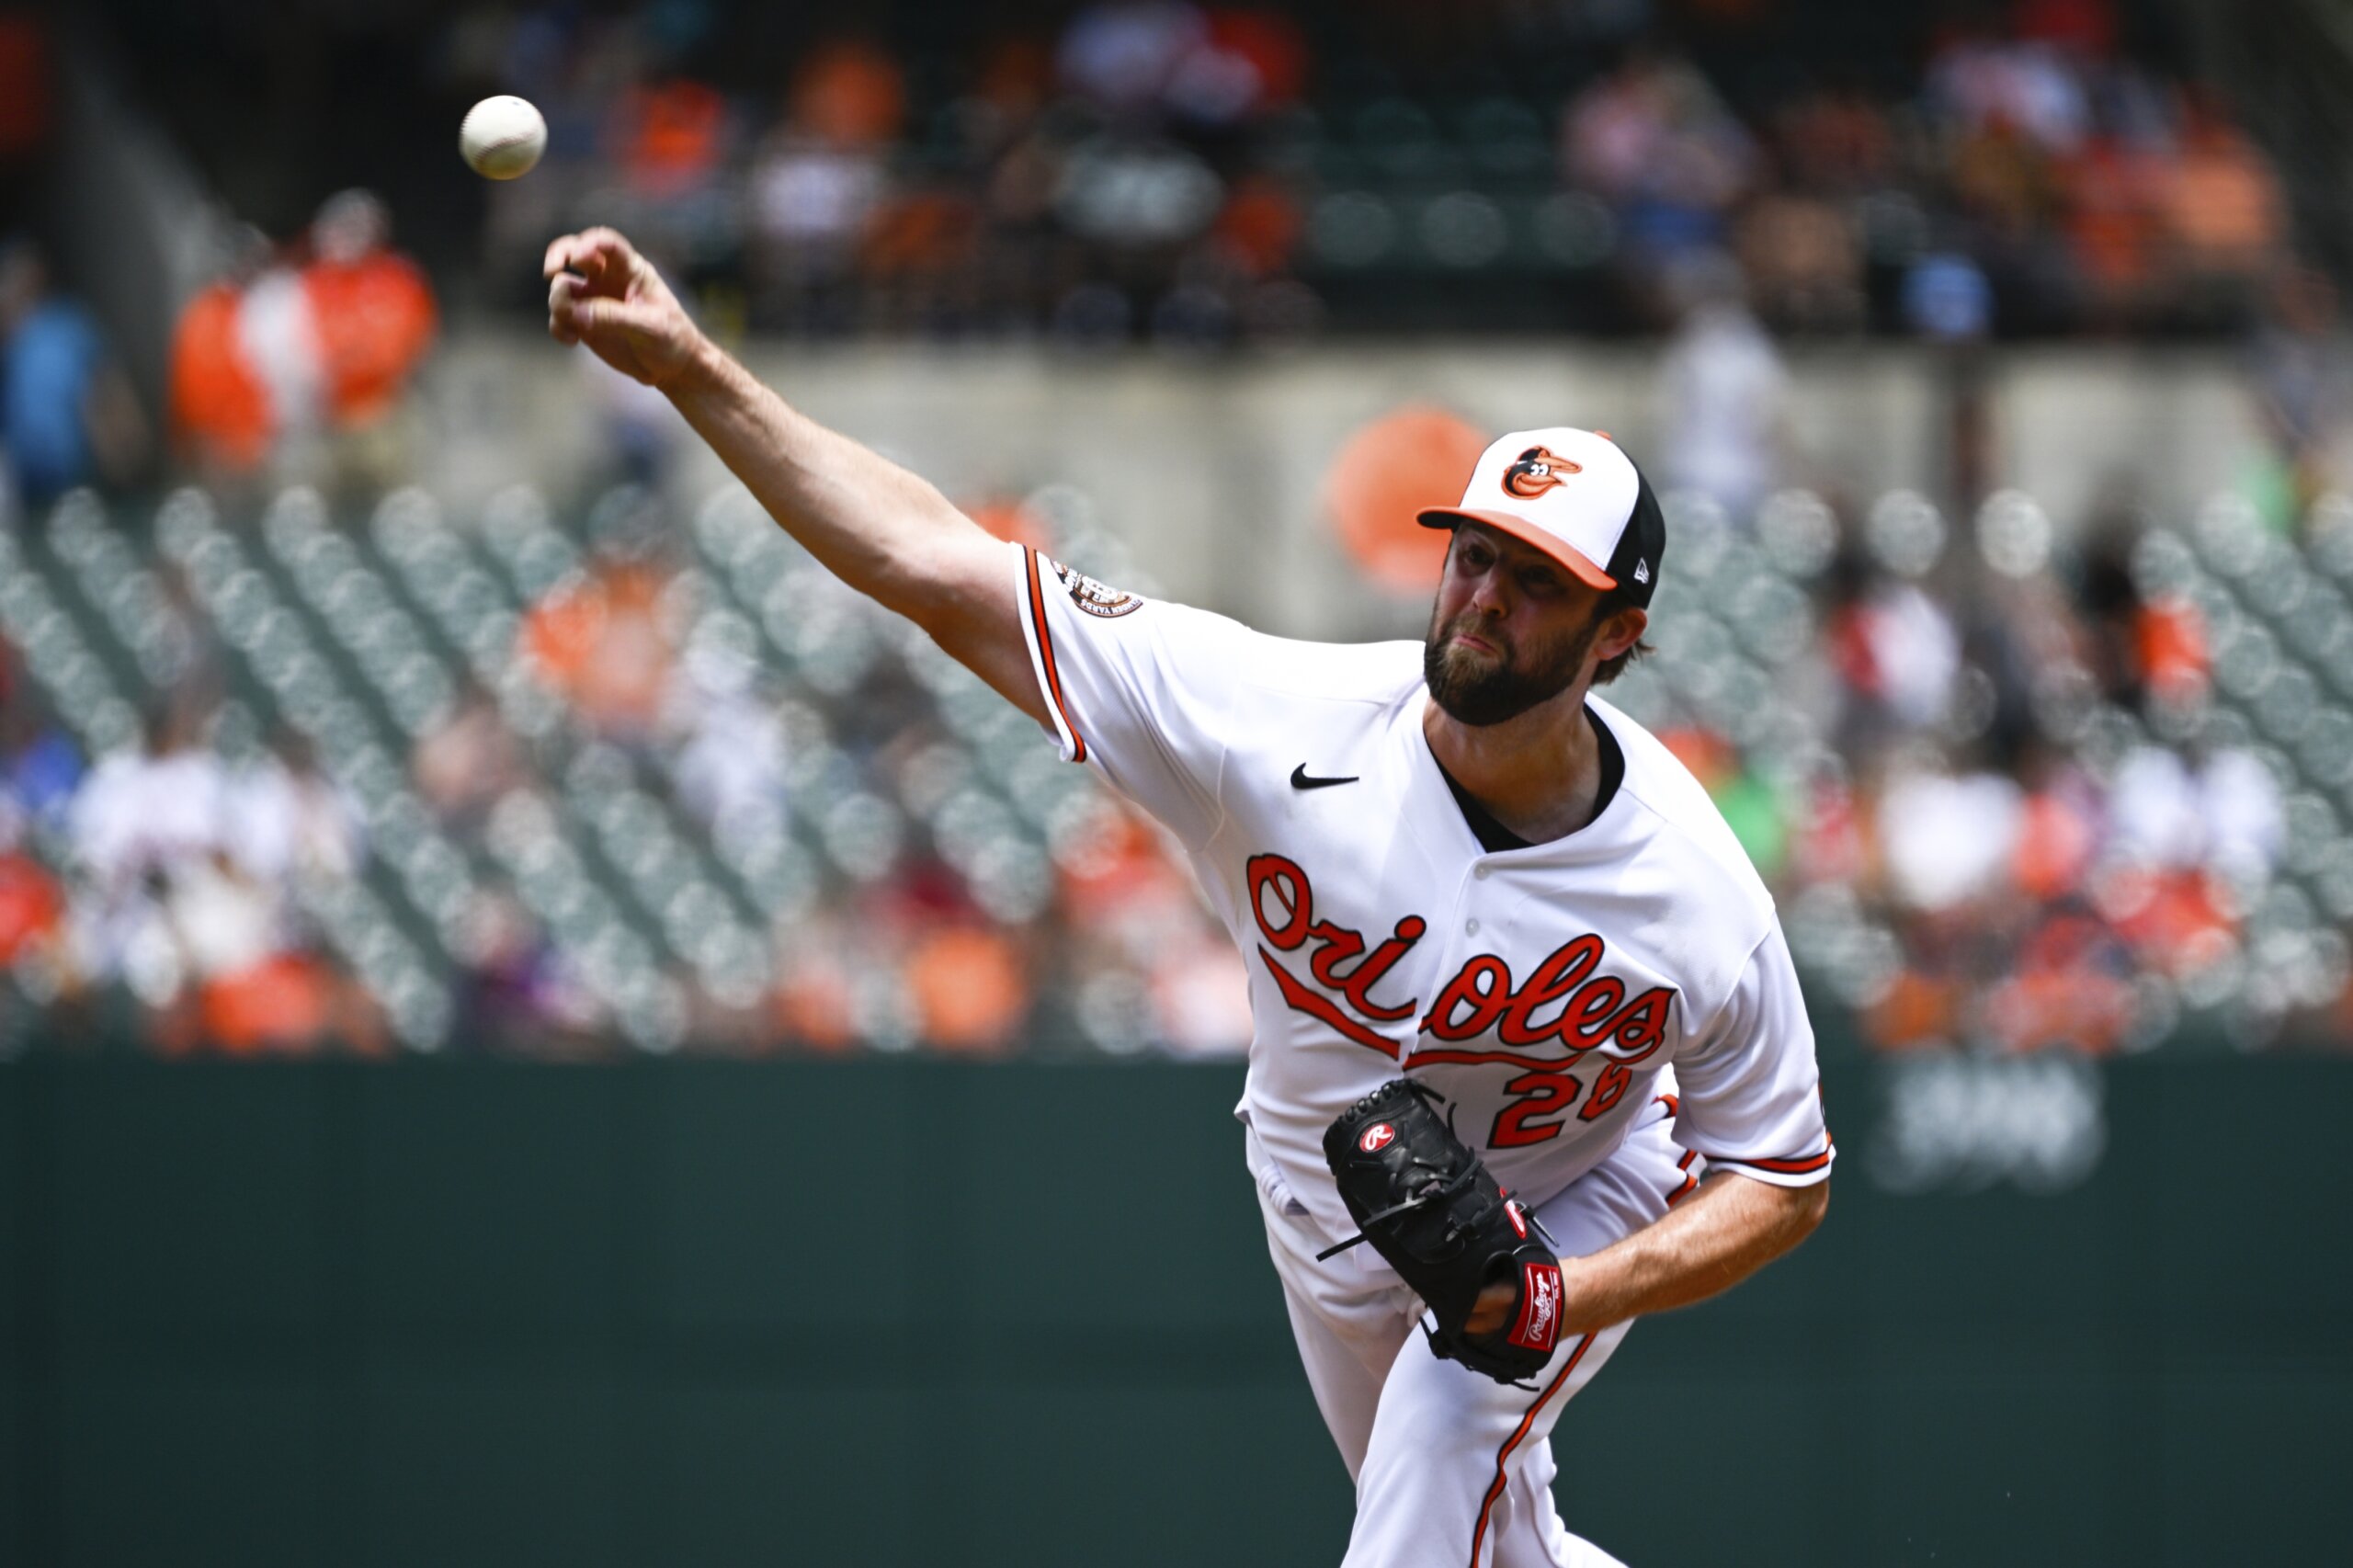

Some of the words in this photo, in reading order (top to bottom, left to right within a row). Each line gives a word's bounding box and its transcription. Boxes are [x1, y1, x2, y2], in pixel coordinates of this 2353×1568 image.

[1081, 598, 1110, 614] YARDS
[1246, 853, 1679, 1059] Orioles
[1529, 1272, 1552, 1341] Rawlings
